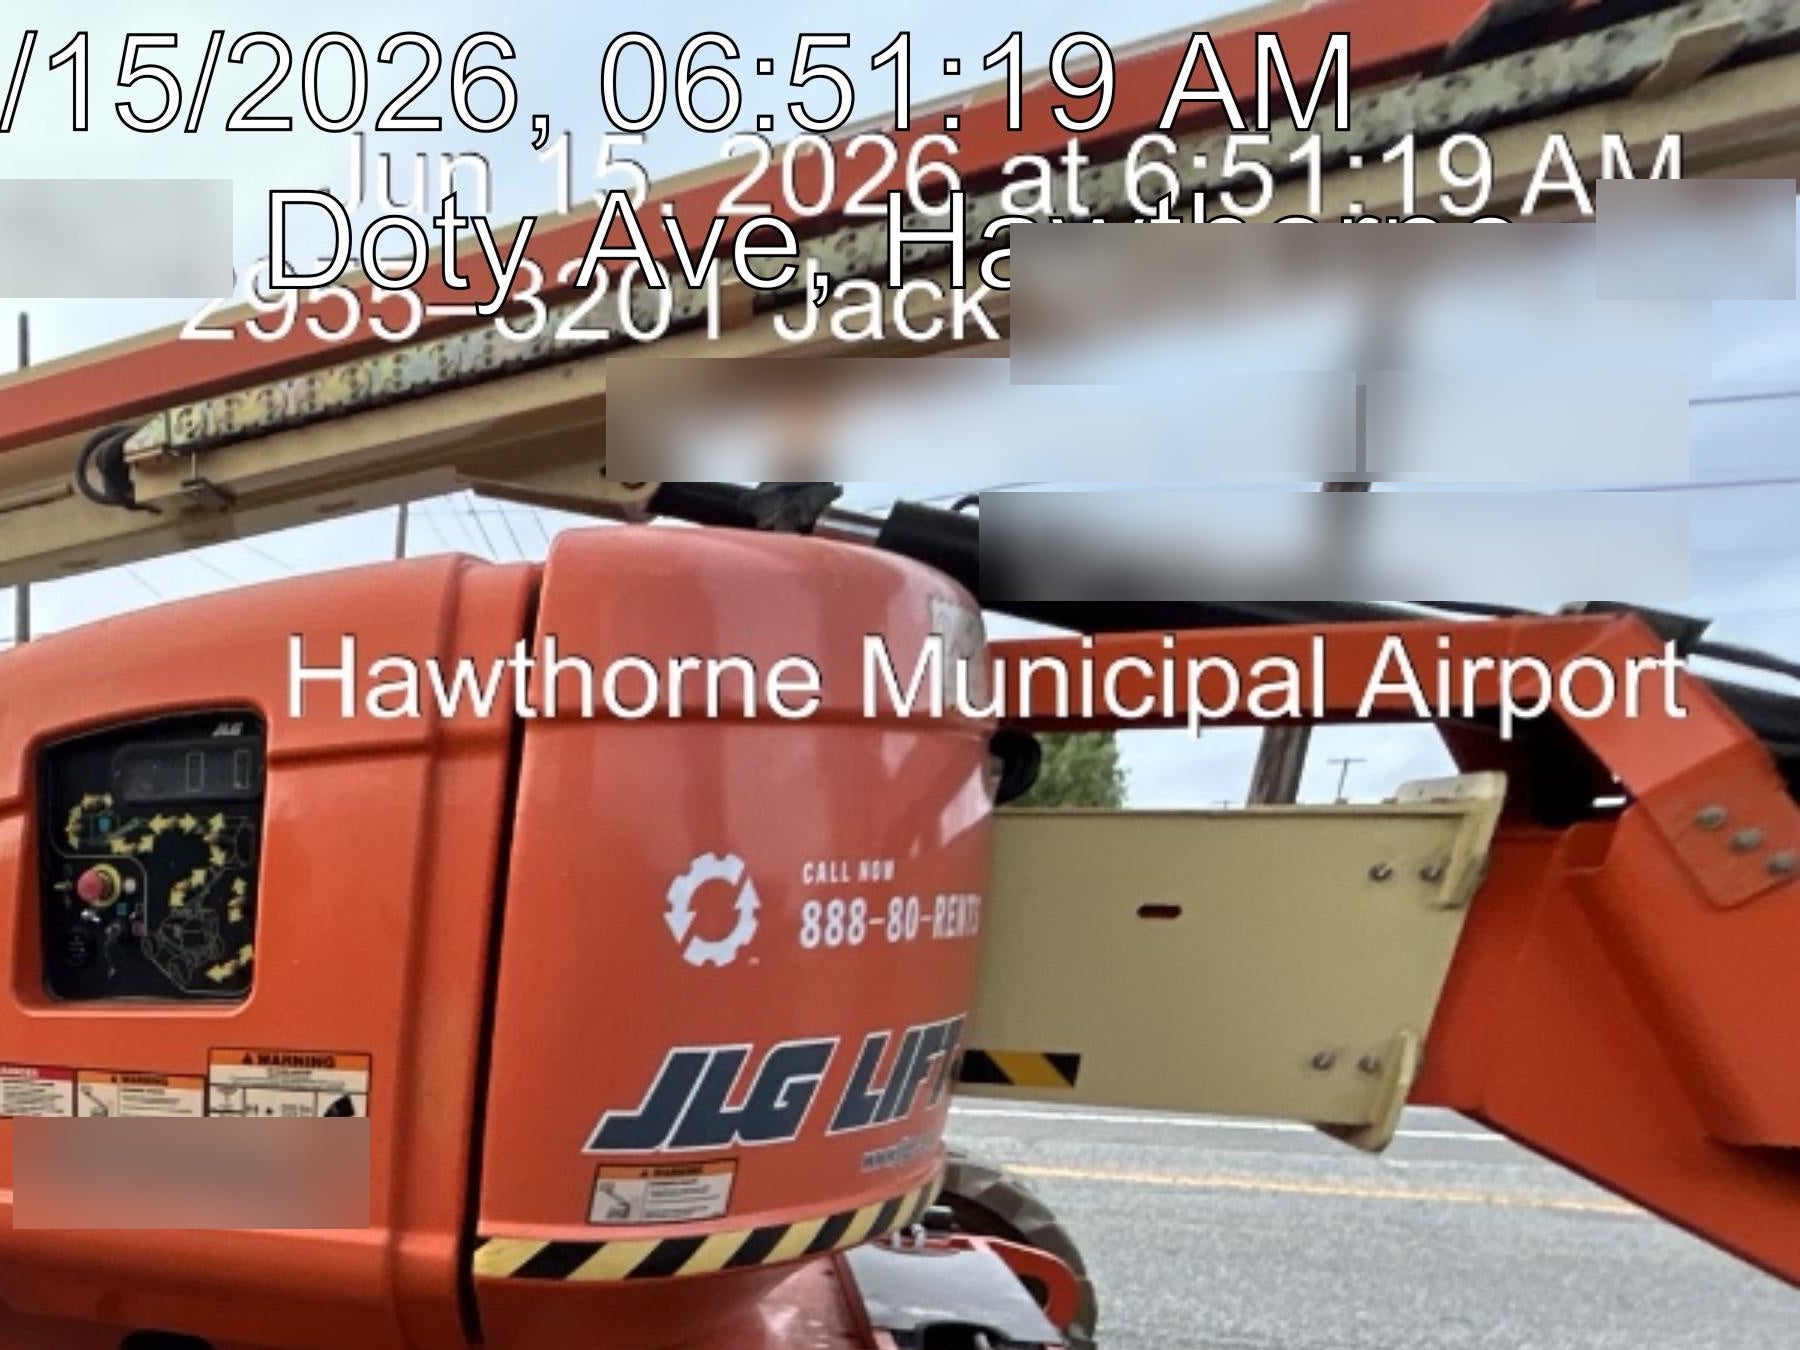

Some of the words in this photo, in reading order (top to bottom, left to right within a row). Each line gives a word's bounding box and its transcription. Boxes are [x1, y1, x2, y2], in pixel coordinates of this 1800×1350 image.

[802, 860, 850, 885] CALL
[857, 859, 895, 883] NOW
[582, 1036, 841, 1154] JLG
[824, 1012, 967, 1137] LIFT
